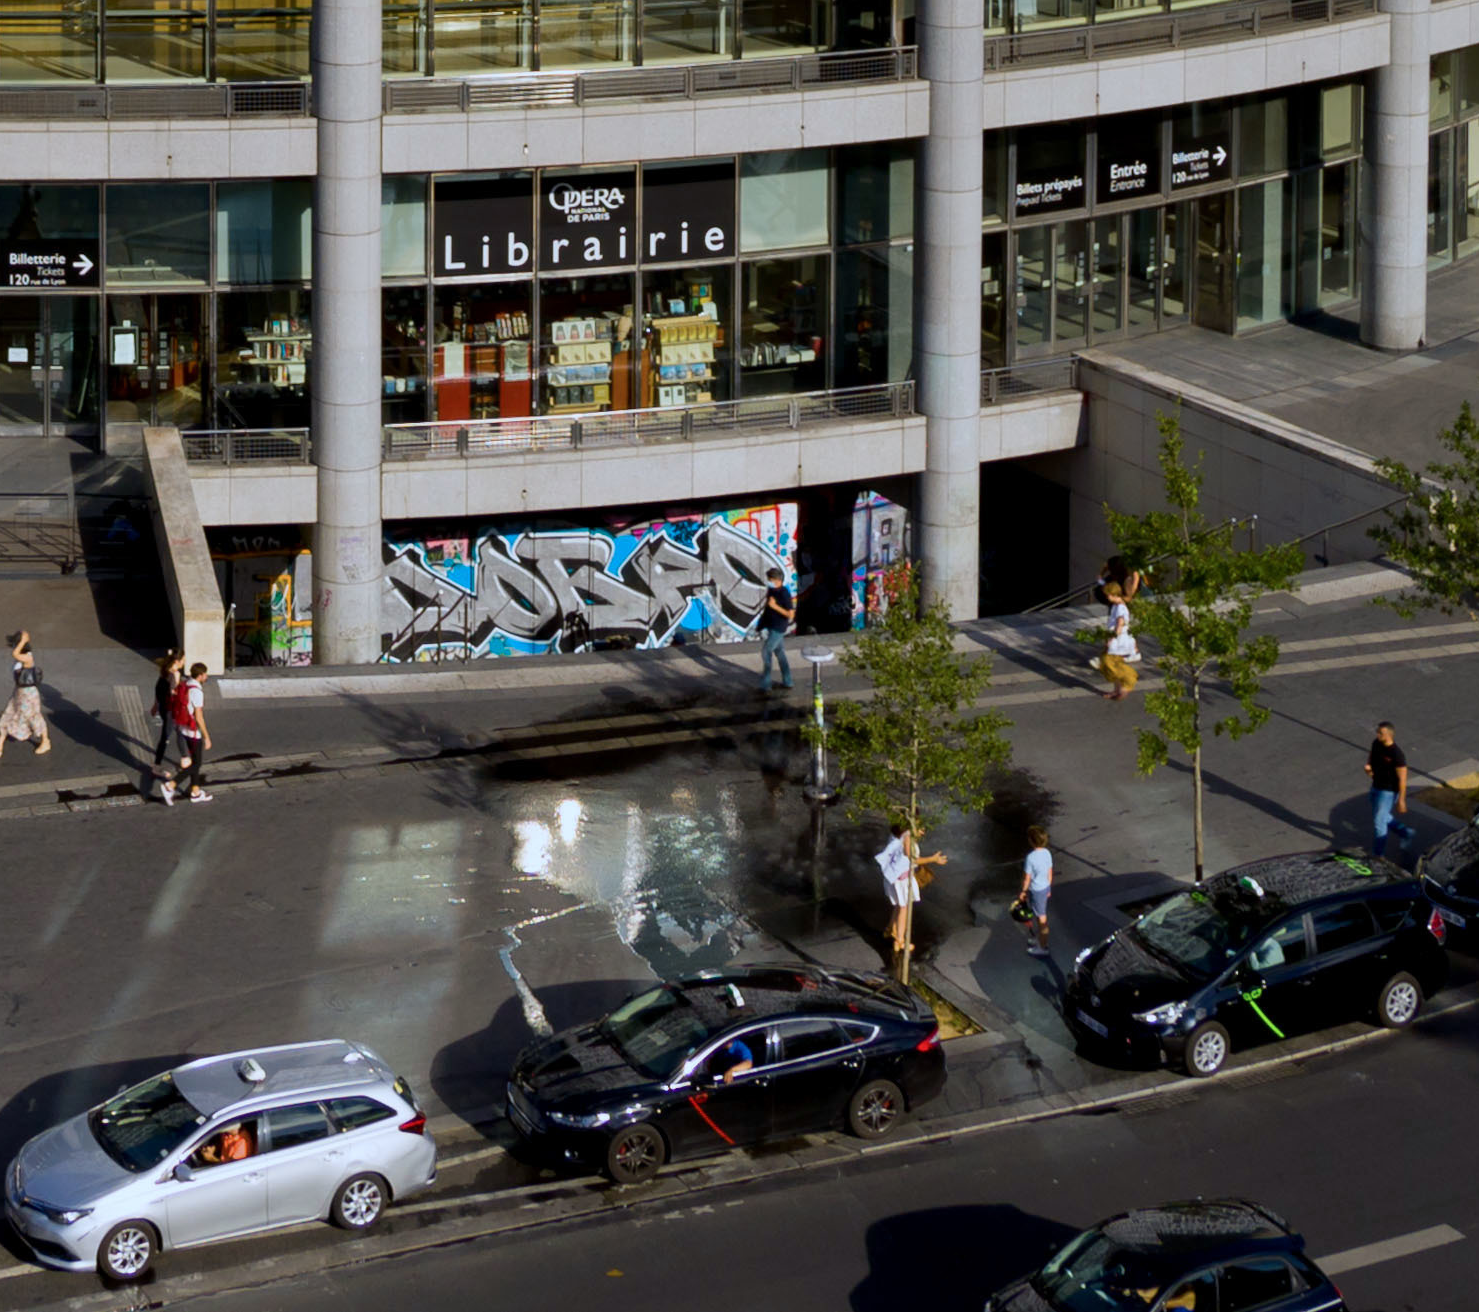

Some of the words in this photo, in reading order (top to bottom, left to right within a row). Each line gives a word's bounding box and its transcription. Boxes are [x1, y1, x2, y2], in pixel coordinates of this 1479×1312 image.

[1109, 160, 1148, 179] Entrée
[1016, 183, 1043, 195] Billets
[1043, 175, 1083, 194] prépayés
[1109, 178, 1146, 192] Entrance
[567, 215, 580, 224] DE
[582, 212, 611, 223] PARIS
[444, 221, 726, 271] Librairie
[9, 252, 67, 266] Billetterie
[36, 266, 66, 276] Tickets
[8, 273, 30, 286] 120
